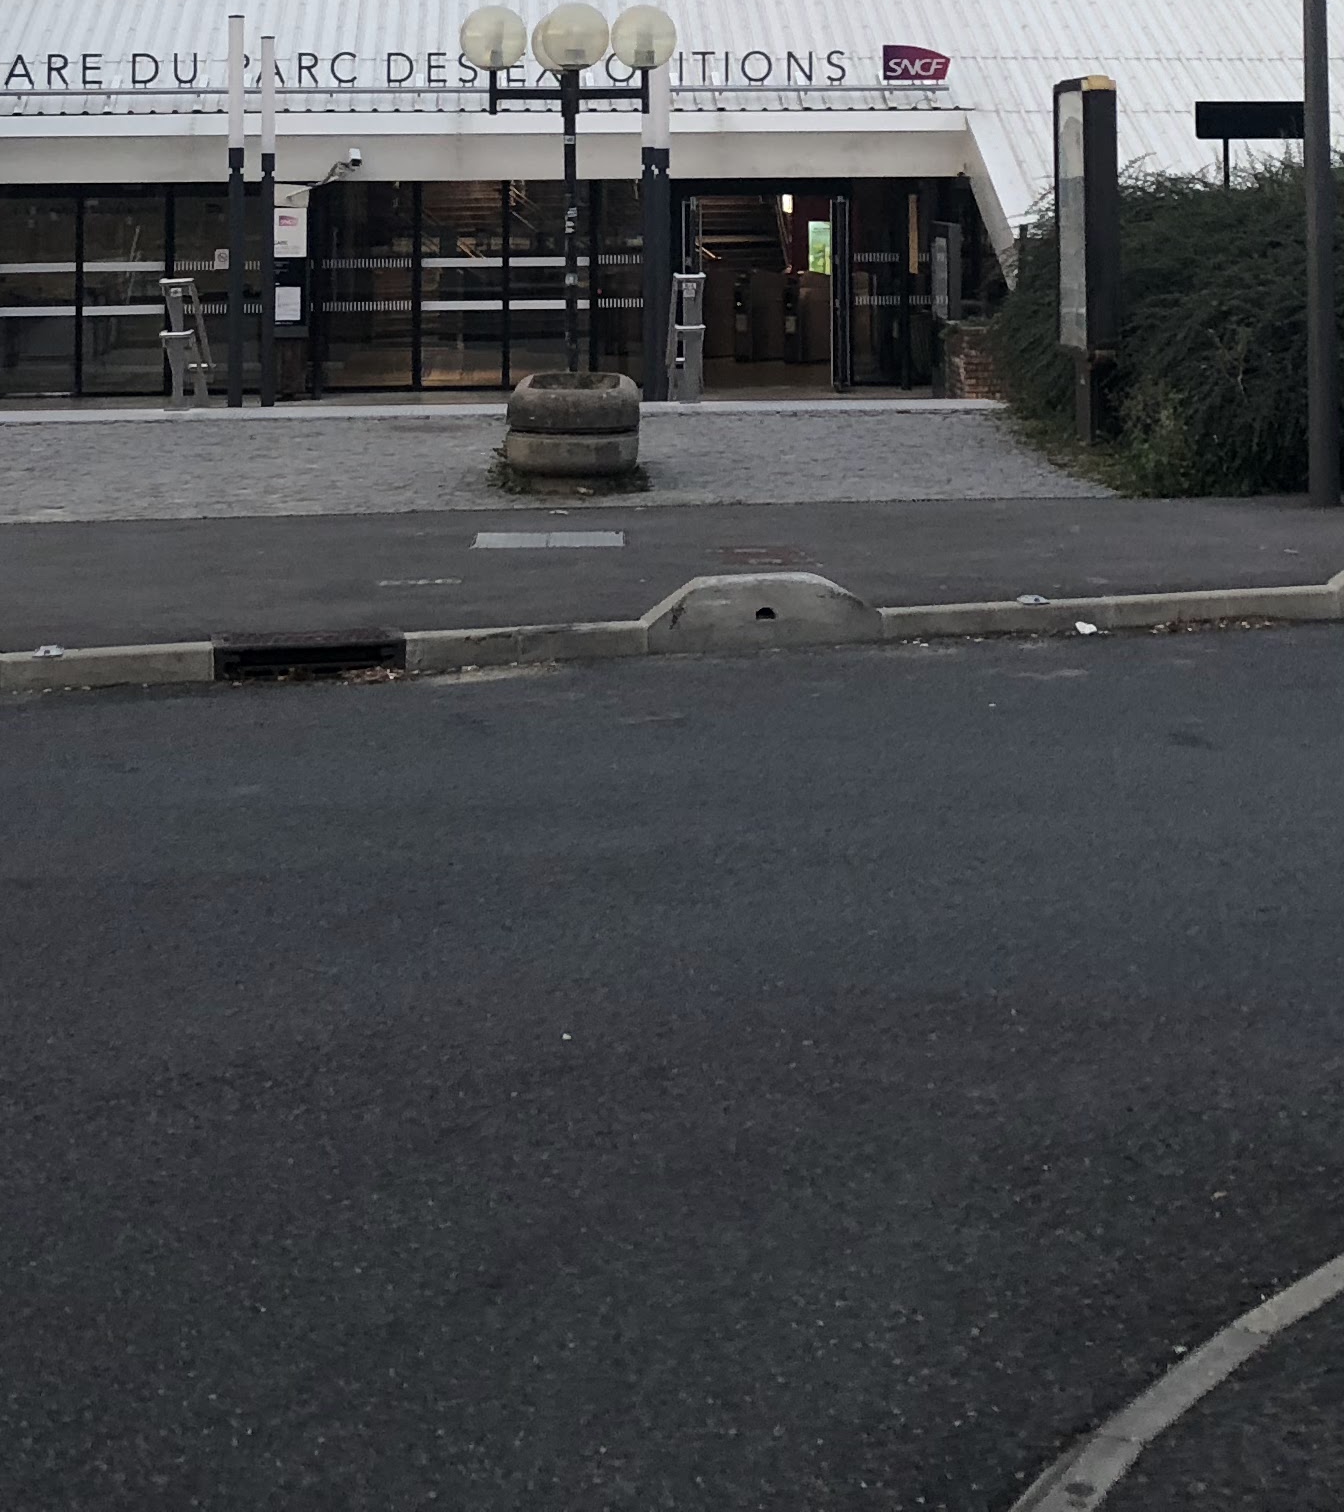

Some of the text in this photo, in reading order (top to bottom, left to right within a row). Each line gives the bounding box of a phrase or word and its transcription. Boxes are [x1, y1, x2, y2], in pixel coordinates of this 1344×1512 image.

[131, 52, 198, 85] DU
[387, 51, 478, 84] DES
[886, 58, 946, 76] SNCF
